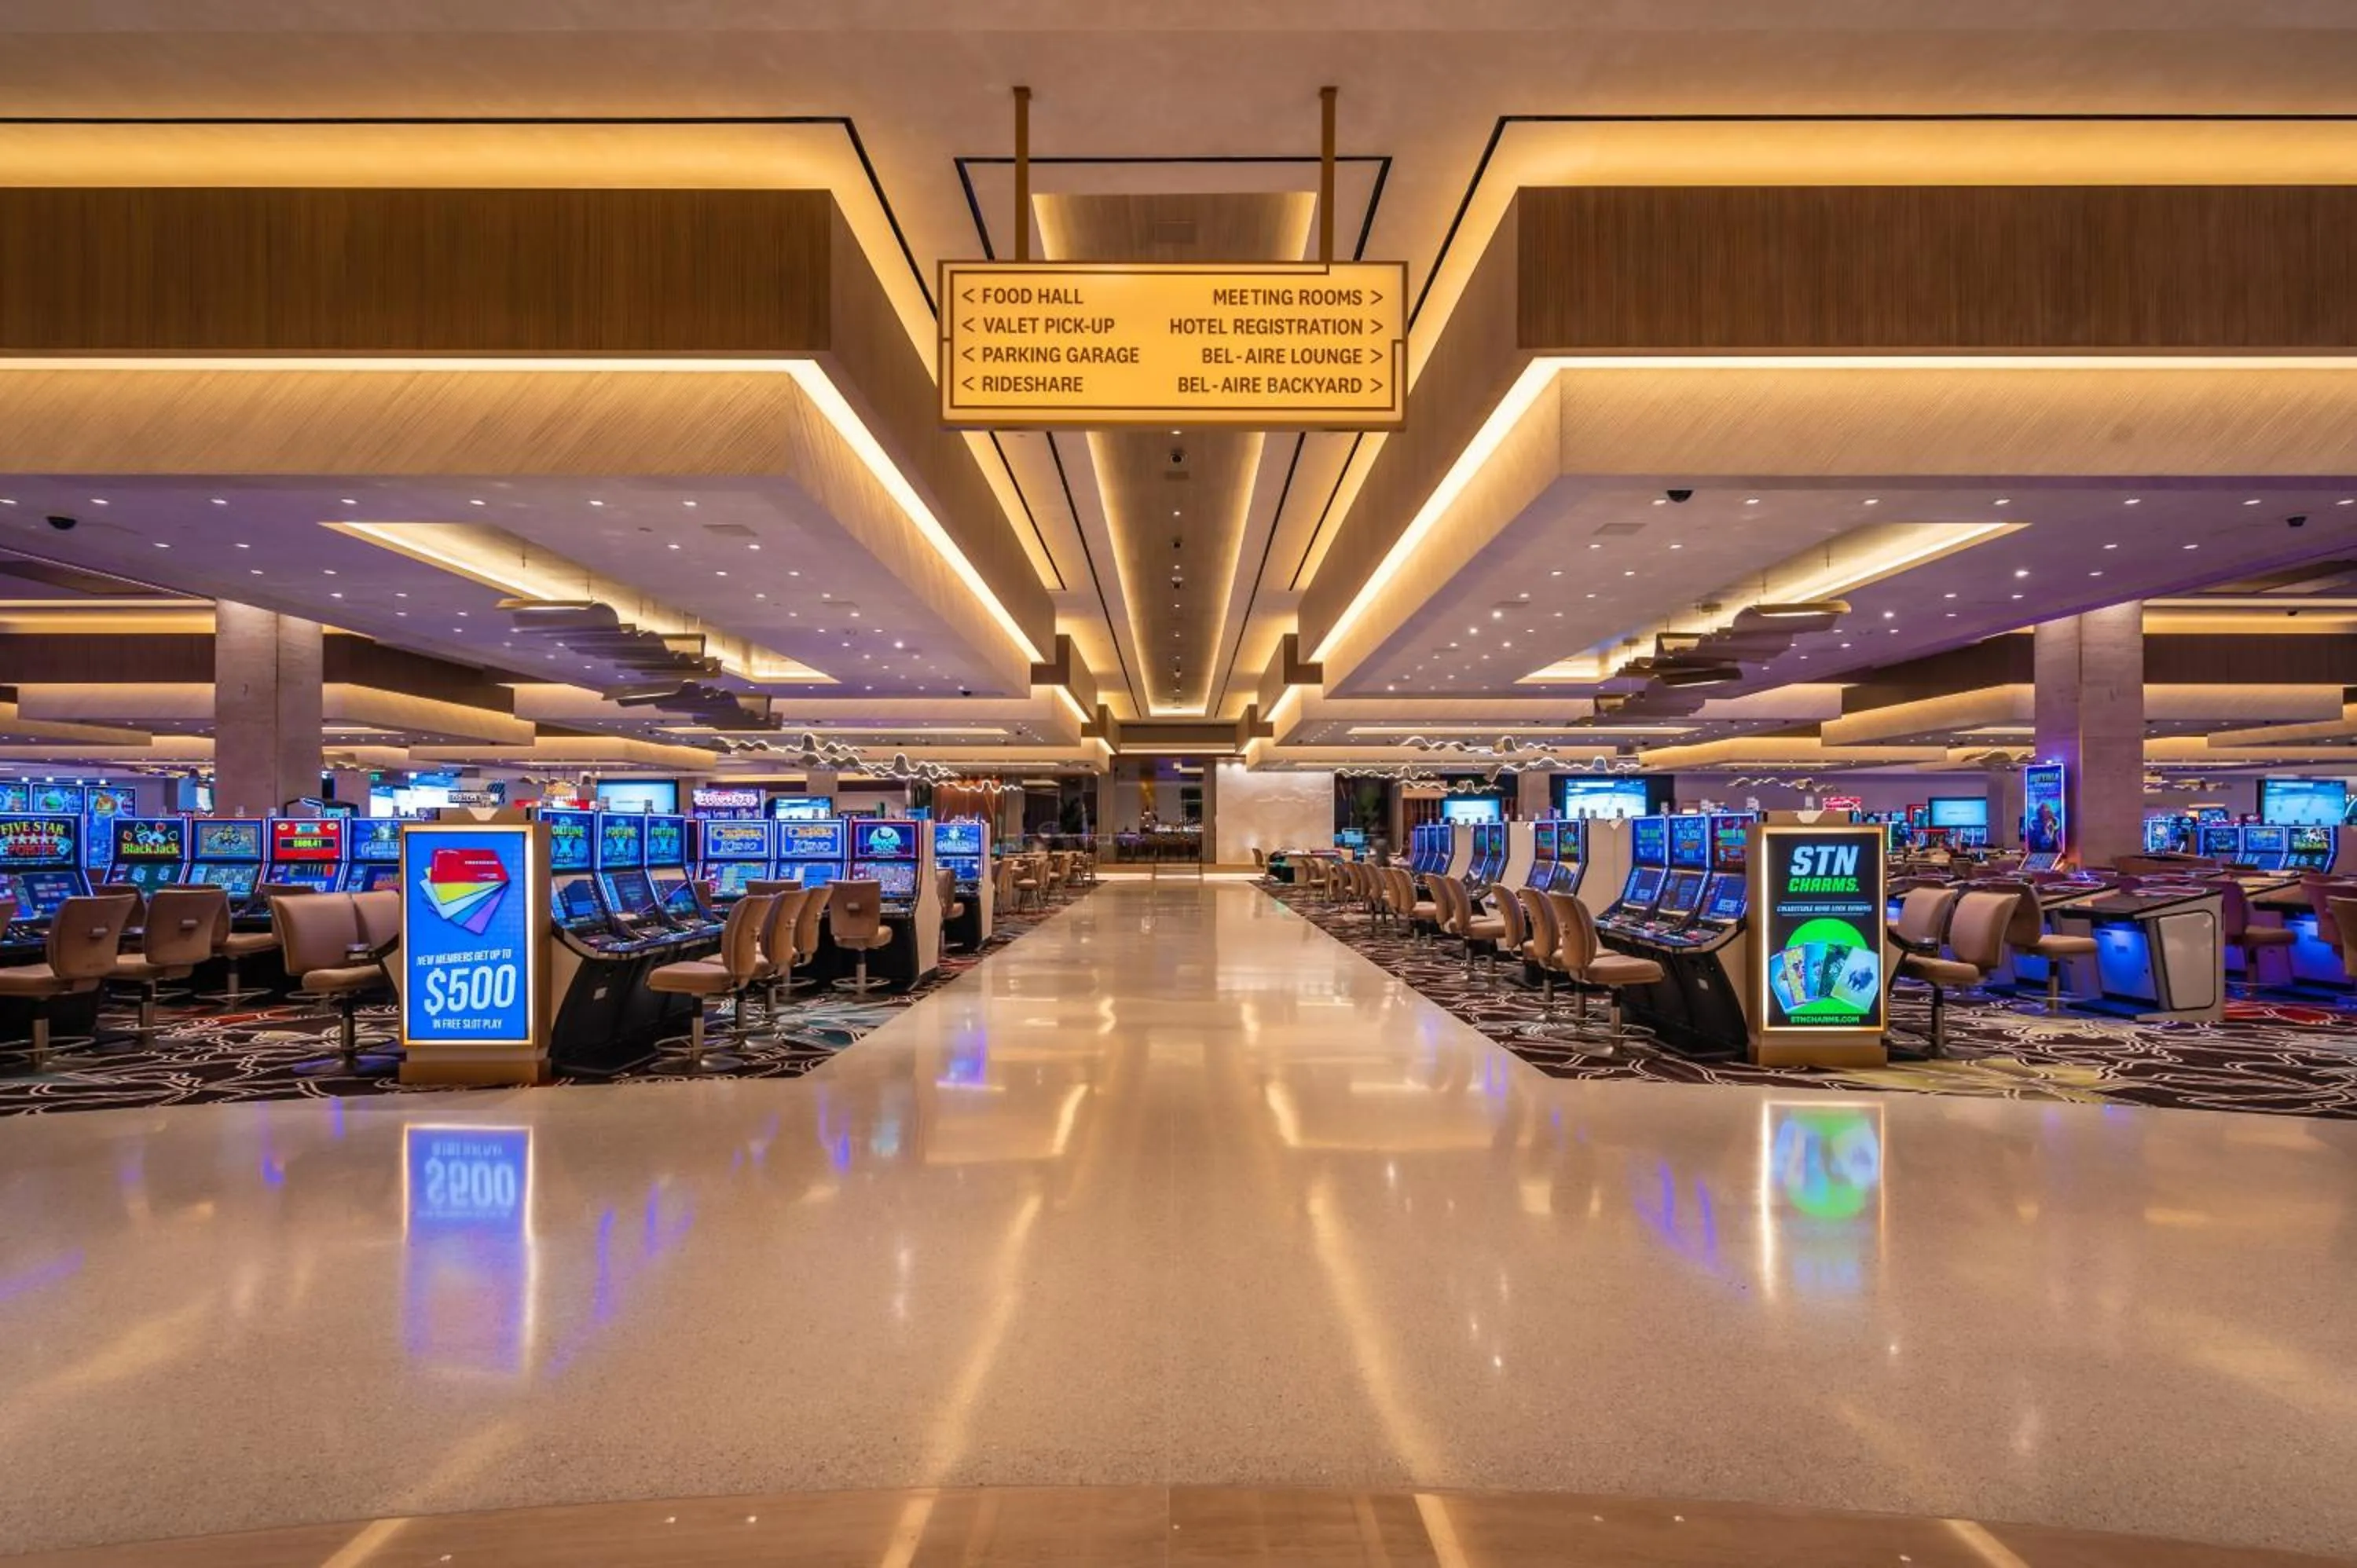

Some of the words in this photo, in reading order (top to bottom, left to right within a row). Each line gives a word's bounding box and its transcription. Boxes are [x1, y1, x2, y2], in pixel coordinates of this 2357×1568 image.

[982, 288, 1032, 305] FOOD
[1037, 288, 1084, 305] HALL
[1212, 288, 1293, 306] MEETING
[1298, 288, 1363, 306] ROOMS
[983, 317, 1039, 335] VALET
[1044, 317, 1116, 335] PICK-UP
[1169, 317, 1228, 335] HOTEL
[1233, 317, 1363, 336] REGISTRATION
[982, 346, 1061, 364] PARKING
[1065, 346, 1139, 365] GARAGE
[1201, 346, 1286, 365] BEL-AIRE
[1291, 347, 1363, 365] LOUNGE
[982, 375, 1083, 393] RIDESHARE
[1177, 376, 1263, 394] BEL-AIRE
[1266, 376, 1363, 394] BACKYARD
[1, 821, 31, 835] FIVE
[33, 821, 65, 835] STAR
[1790, 845, 1860, 876] STN
[1788, 877, 1860, 893] CHARMS.
[416, 955, 434, 966] NEW
[435, 951, 473, 965] MEMBERS
[475, 951, 488, 962] GET
[489, 949, 500, 961] UP
[502, 948, 511, 959] TO
[423, 964, 516, 1016] $500
[433, 1019, 442, 1029] IN
[442, 1019, 462, 1029] FREE
[463, 1019, 481, 1029] SLOT
[482, 1019, 503, 1029] PLAY
